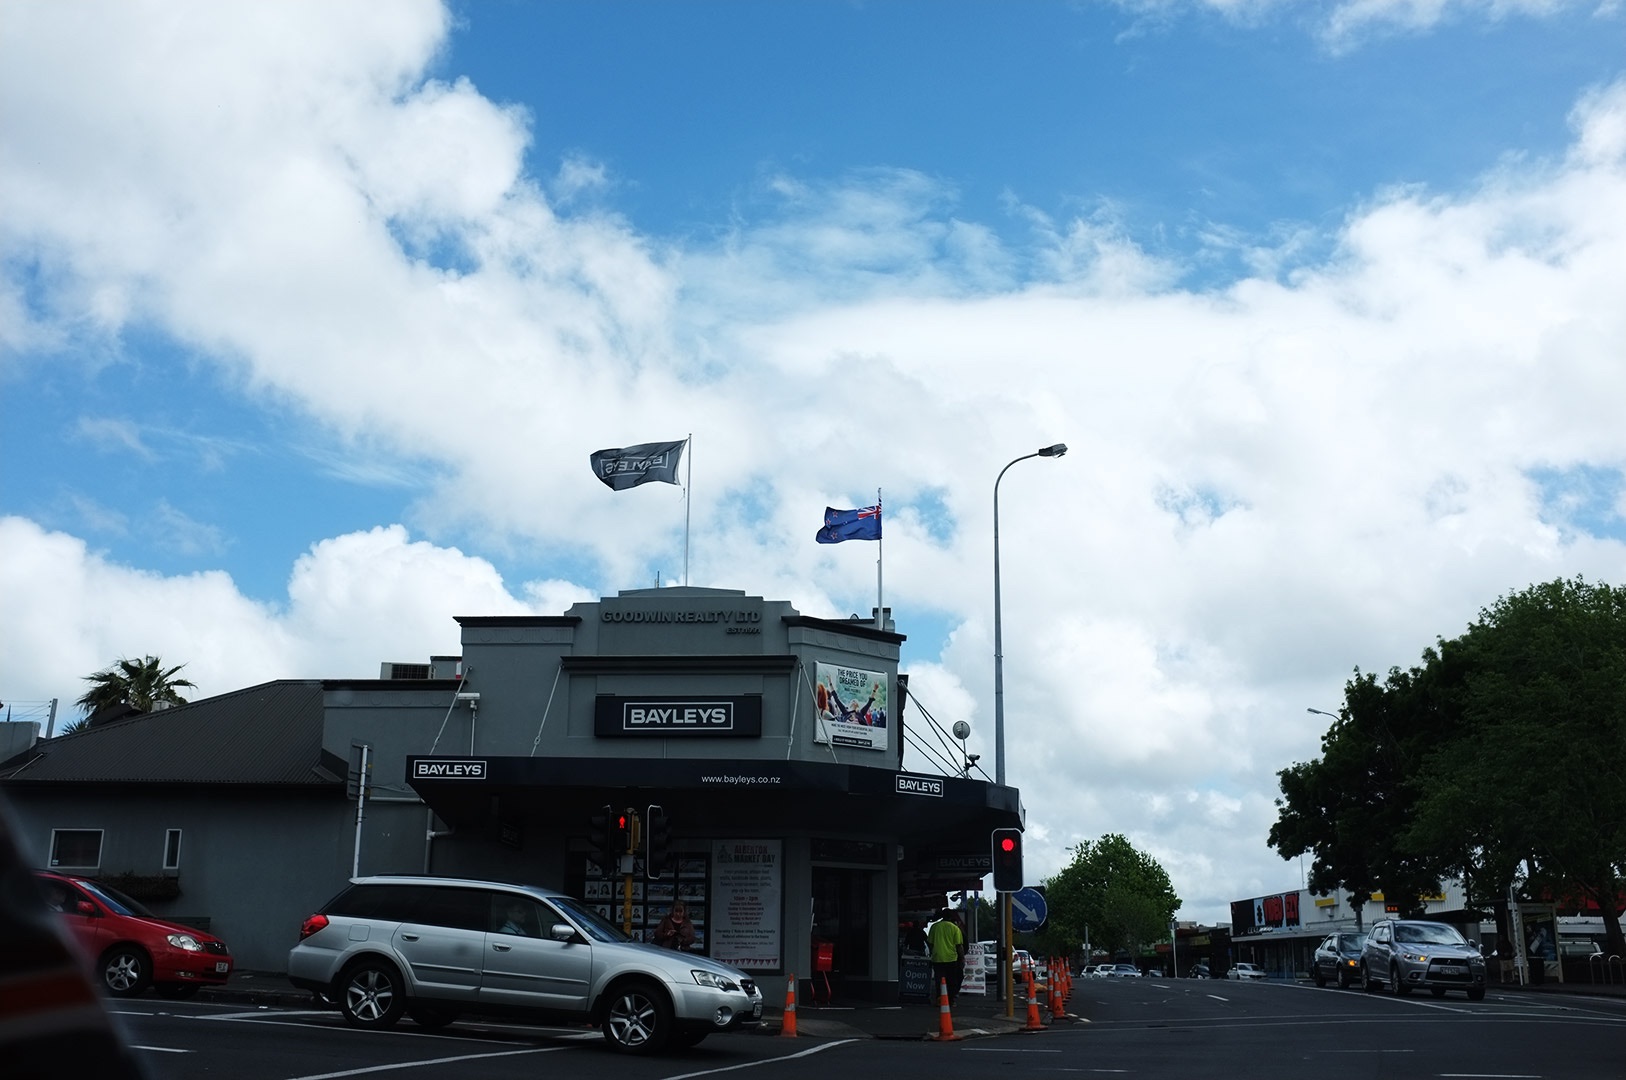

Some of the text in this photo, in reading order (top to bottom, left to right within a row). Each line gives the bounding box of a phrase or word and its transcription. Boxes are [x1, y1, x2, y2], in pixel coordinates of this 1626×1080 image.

[602, 611, 761, 623] GOODWIN REALTY LTD
[837, 668, 868, 681] THE PRICE YOU
[839, 676, 866, 688] DREAMED OF
[631, 708, 727, 724] BAYLEYS
[418, 764, 482, 775] BAYLEYS
[701, 774, 781, 785] www.bayleys.co.nz
[899, 779, 941, 793] BAYLEYS
[734, 854, 776, 863] MARKET DAY
[940, 857, 991, 868] BAYLEYS
[905, 969, 928, 980] Open
[906, 981, 926, 990] Now
